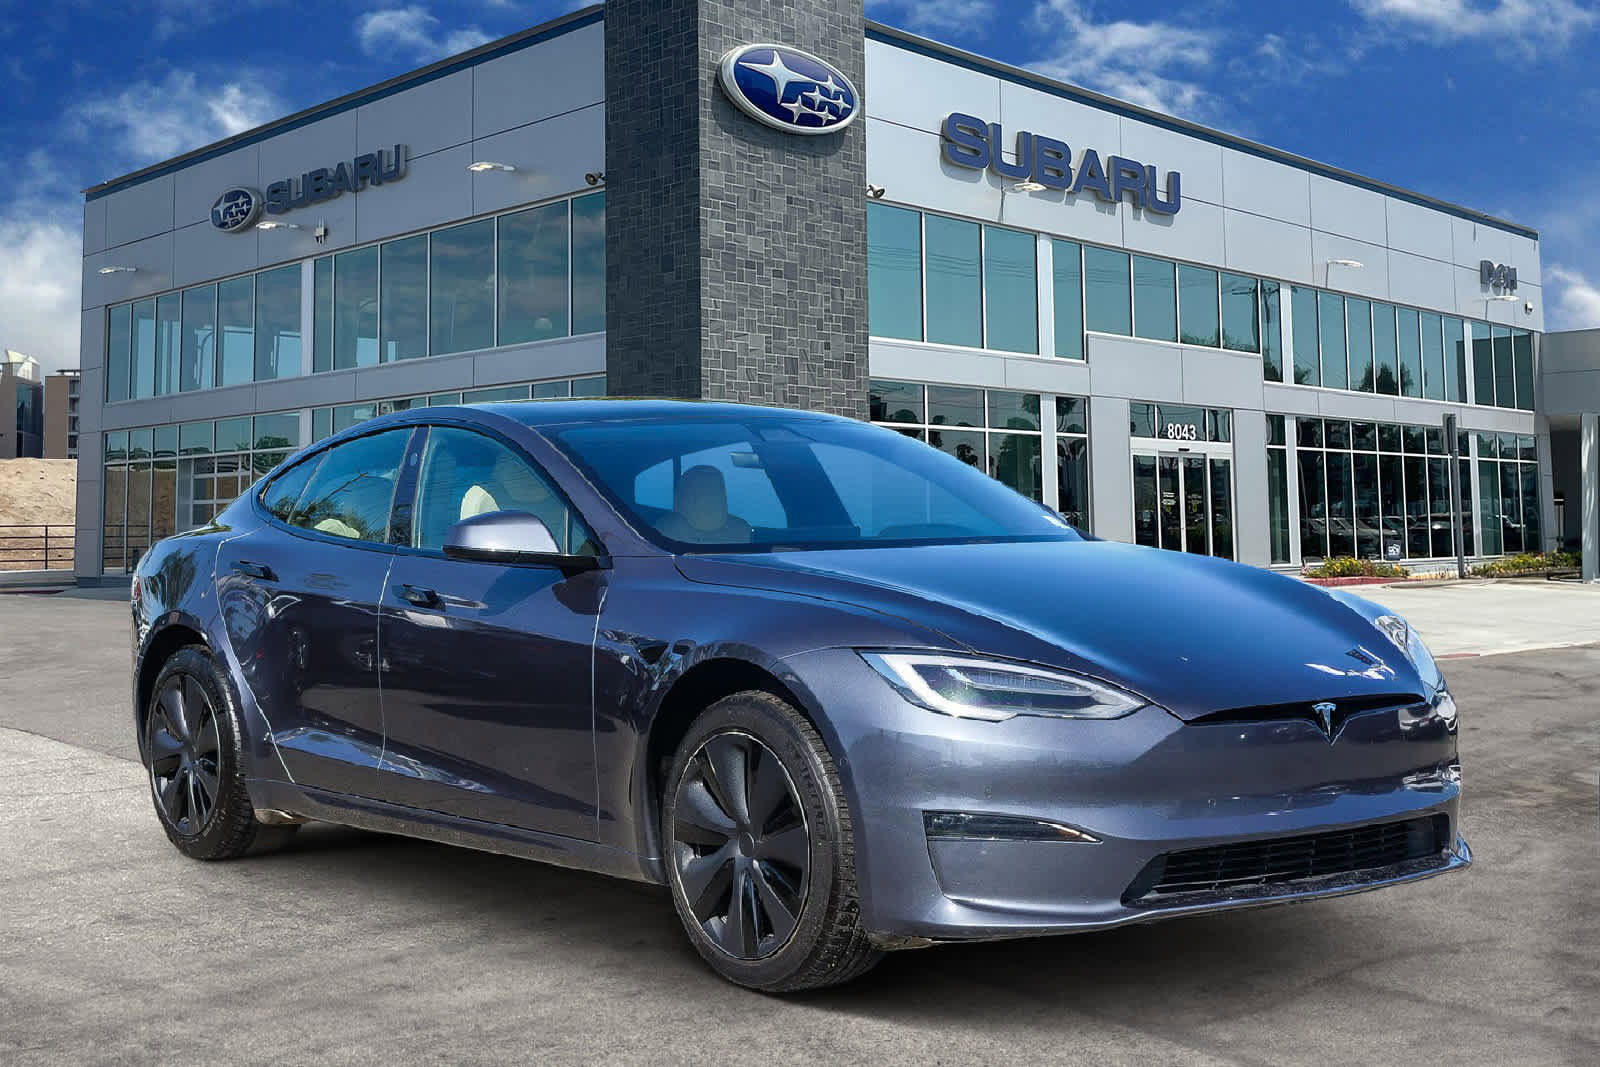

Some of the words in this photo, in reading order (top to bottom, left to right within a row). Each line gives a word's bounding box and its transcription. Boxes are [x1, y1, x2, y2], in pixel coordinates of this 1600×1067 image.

[266, 144, 405, 214] SUBARU
[942, 112, 1181, 215] SUBARU
[1167, 423, 1196, 440] 8043
